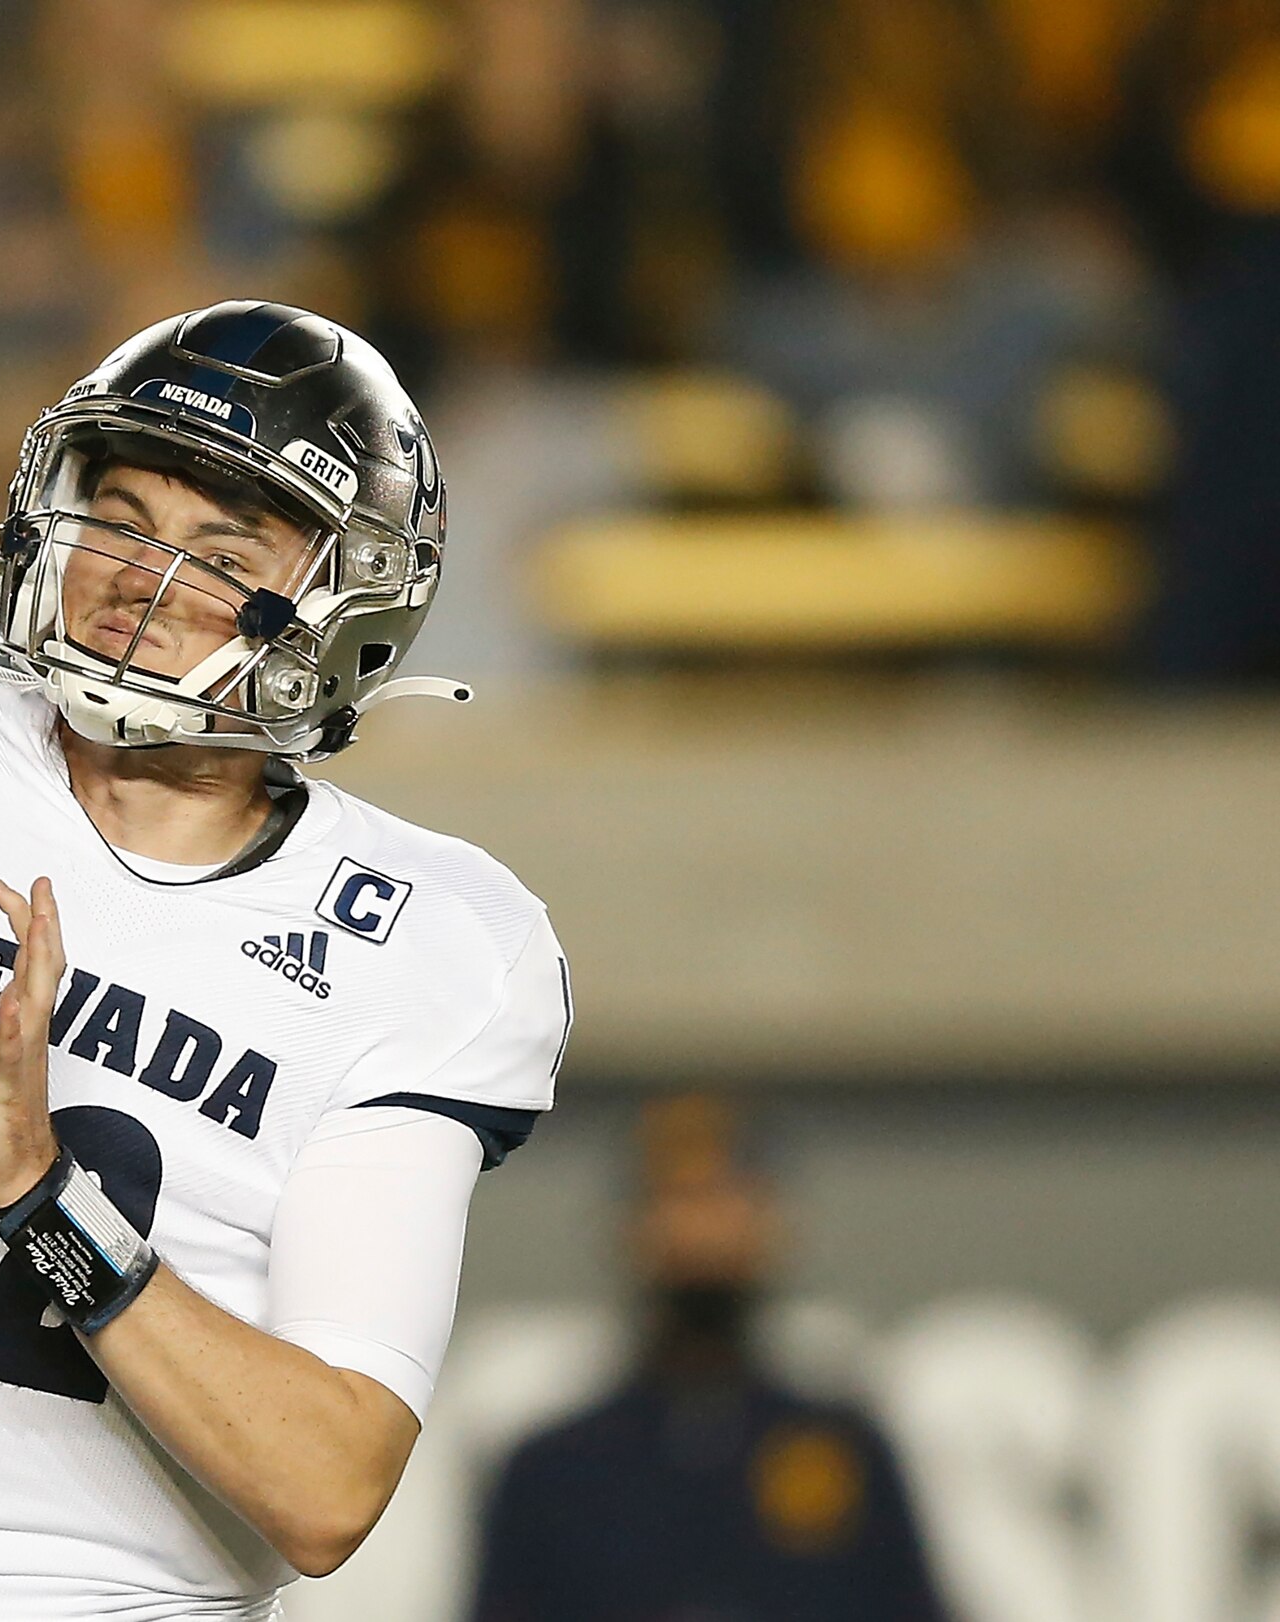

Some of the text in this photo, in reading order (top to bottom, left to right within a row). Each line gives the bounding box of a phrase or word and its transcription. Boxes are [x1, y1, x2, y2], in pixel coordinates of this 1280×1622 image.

[158, 382, 233, 420] NEVADA
[299, 447, 350, 490] GRIT
[332, 872, 396, 933] C
[239, 938, 332, 1000] adidas
[25, 1242, 80, 1305] Wrist Plan
